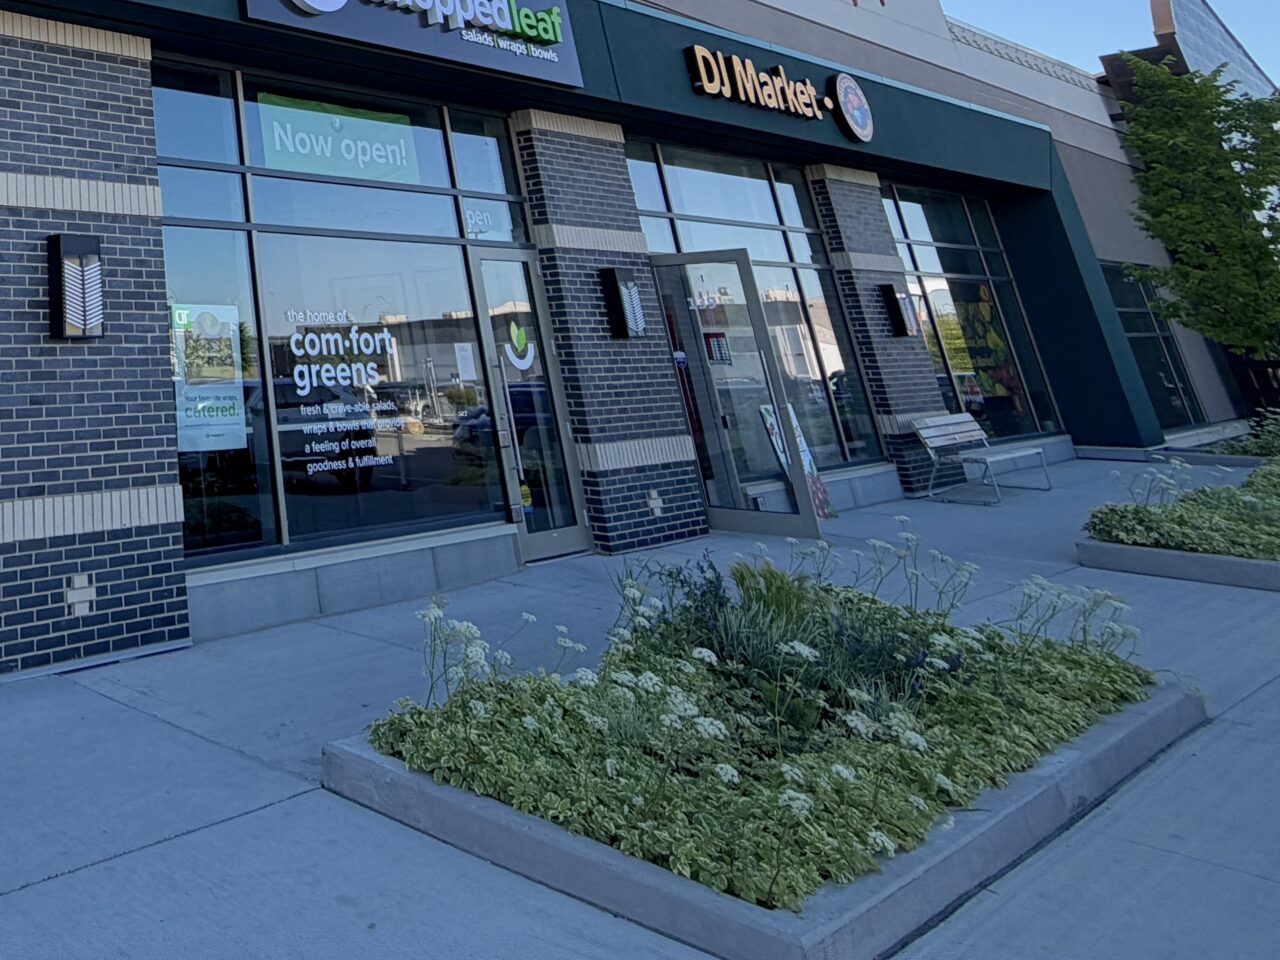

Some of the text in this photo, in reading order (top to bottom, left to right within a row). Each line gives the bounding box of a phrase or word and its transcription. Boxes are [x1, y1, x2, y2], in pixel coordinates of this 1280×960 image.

[461, 29, 559, 62] salads wraps bowls
[694, 44, 732, 99] DJ
[732, 54, 823, 121] Market
[272, 120, 407, 168] Now open!
[466, 210, 492, 229] pen
[287, 309, 348, 322] the home of
[293, 361, 381, 397] greens
[185, 401, 240, 419] catered.
[300, 404, 321, 416] fresh
[302, 424, 328, 436] wraps
[336, 420, 360, 432] bowls
[305, 436, 377, 453] a feeling of overall
[307, 454, 394, 475] goodness & fulfillment
